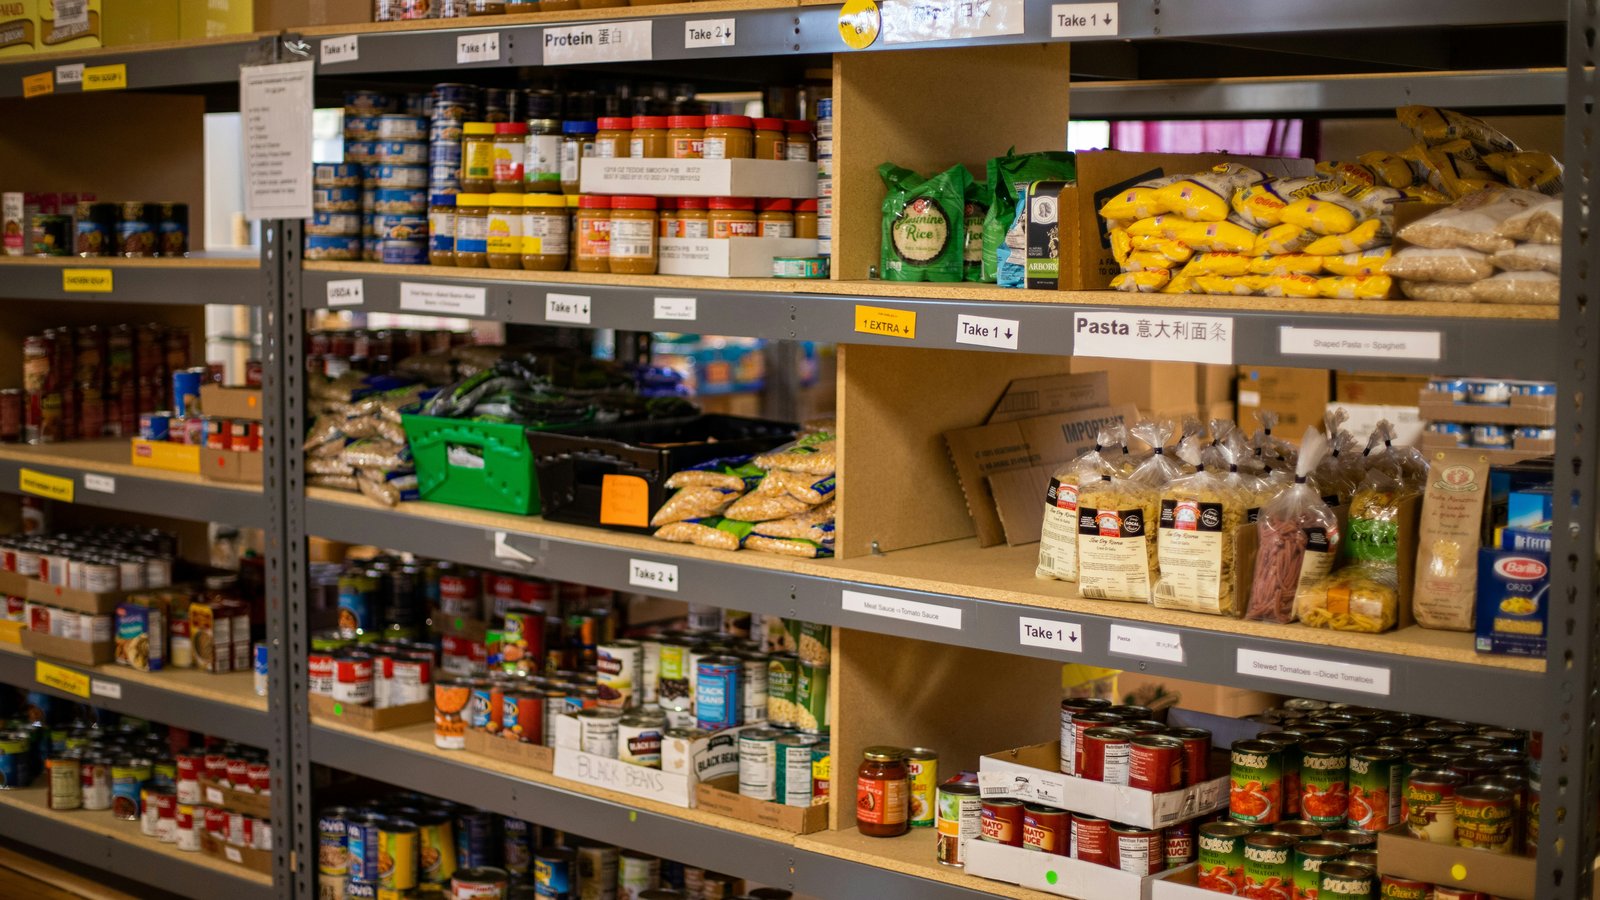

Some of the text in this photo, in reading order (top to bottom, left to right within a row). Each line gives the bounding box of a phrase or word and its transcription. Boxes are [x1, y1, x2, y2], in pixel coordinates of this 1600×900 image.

[1057, 14, 1096, 27] Take 1
[545, 31, 593, 47] Protein
[598, 28, 622, 46] 蛋白
[689, 26, 723, 40] Take 2
[324, 44, 347, 55] Take 1
[461, 42, 487, 53] Take 1
[895, 213, 945, 230] Jasmine
[906, 224, 933, 241] Rice
[330, 286, 350, 298] USDA
[550, 301, 578, 314] Take 1
[863, 319, 900, 334] 1 EXTRA
[963, 322, 998, 339] Take 1
[1077, 317, 1129, 336] Pasta
[1136, 319, 1227, 342] 意大利面条
[1313, 339, 1406, 351] Shaped Pasta Spaghetti
[634, 567, 664, 582] Take 2
[1505, 562, 1543, 575] Barilla
[1505, 583, 1533, 592] ORZO
[864, 602, 939, 620] Meat Sauce Tomato Sauce
[1024, 624, 1062, 641] Take 1
[1252, 660, 1374, 685] Stewed Tomatoes Diced Tomatoes
[630, 742, 652, 750] BLACK
[697, 757, 719, 772] BLACK
[577, 755, 664, 792] BLACK BEANS
[1234, 772, 1261, 781] MATOES
[1456, 802, 1481, 818] Great
[981, 819, 1003, 831] MATO
[981, 826, 999, 838] AUCE
[1024, 825, 1045, 839] MATO
[1024, 834, 1041, 847] AUCE
[1167, 838, 1190, 847] MATO
[1166, 846, 1188, 857] AUCE
[1248, 869, 1281, 877] TOMATOES
[1253, 862, 1273, 870] DICED
[1387, 883, 1420, 898] Choice
